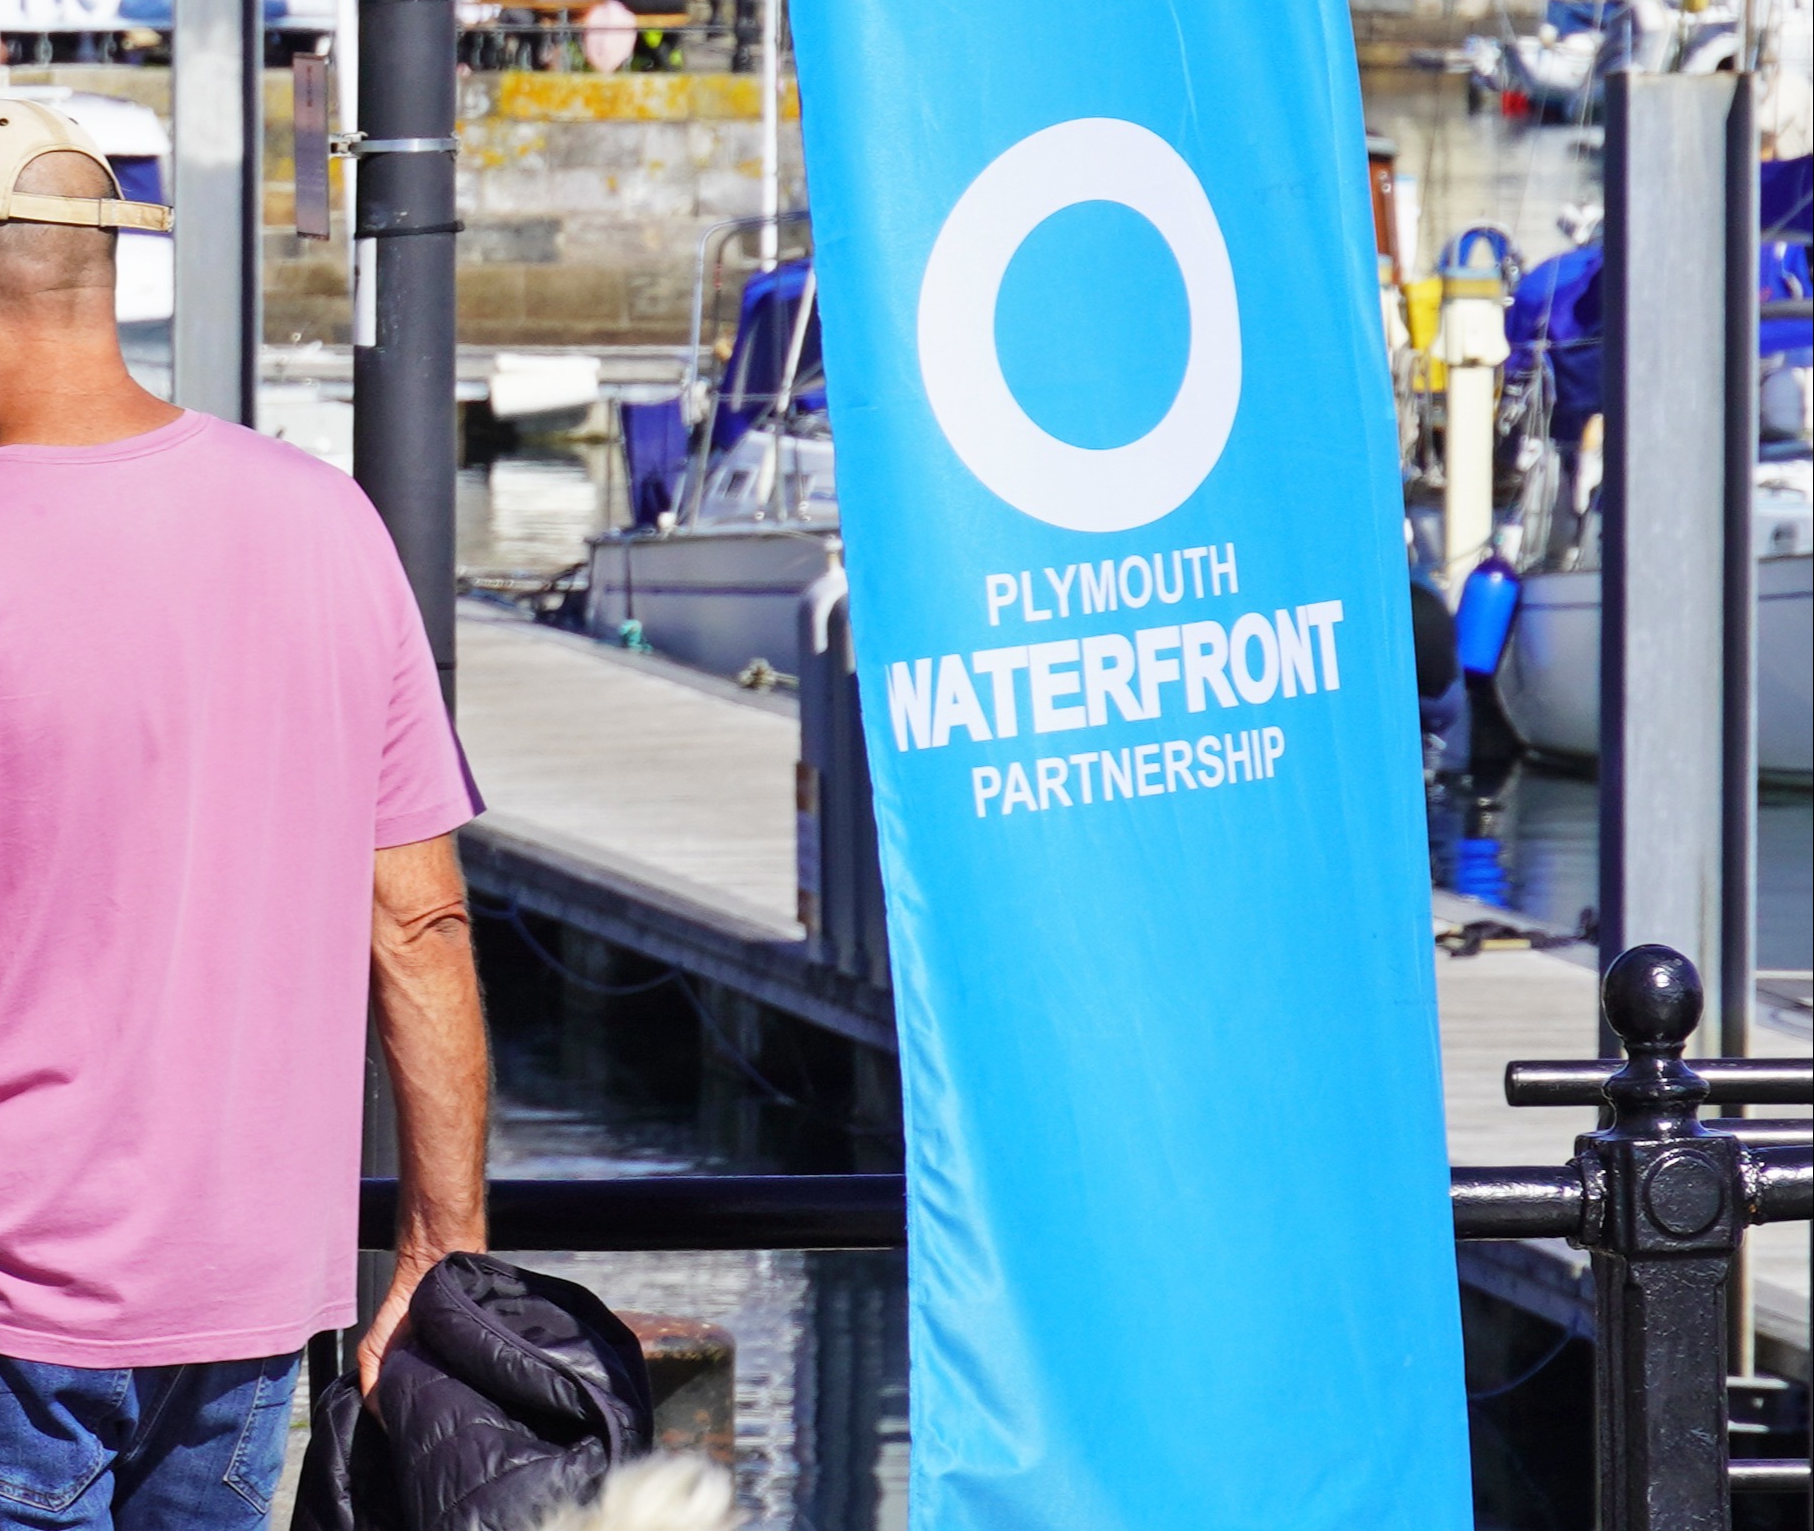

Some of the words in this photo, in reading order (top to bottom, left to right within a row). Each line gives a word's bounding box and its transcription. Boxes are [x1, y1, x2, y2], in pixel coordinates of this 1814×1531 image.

[985, 543, 1239, 626] PLYMOUTH
[886, 601, 1343, 751] WATERFRONT
[973, 726, 1285, 818] PARTNERSHIP
